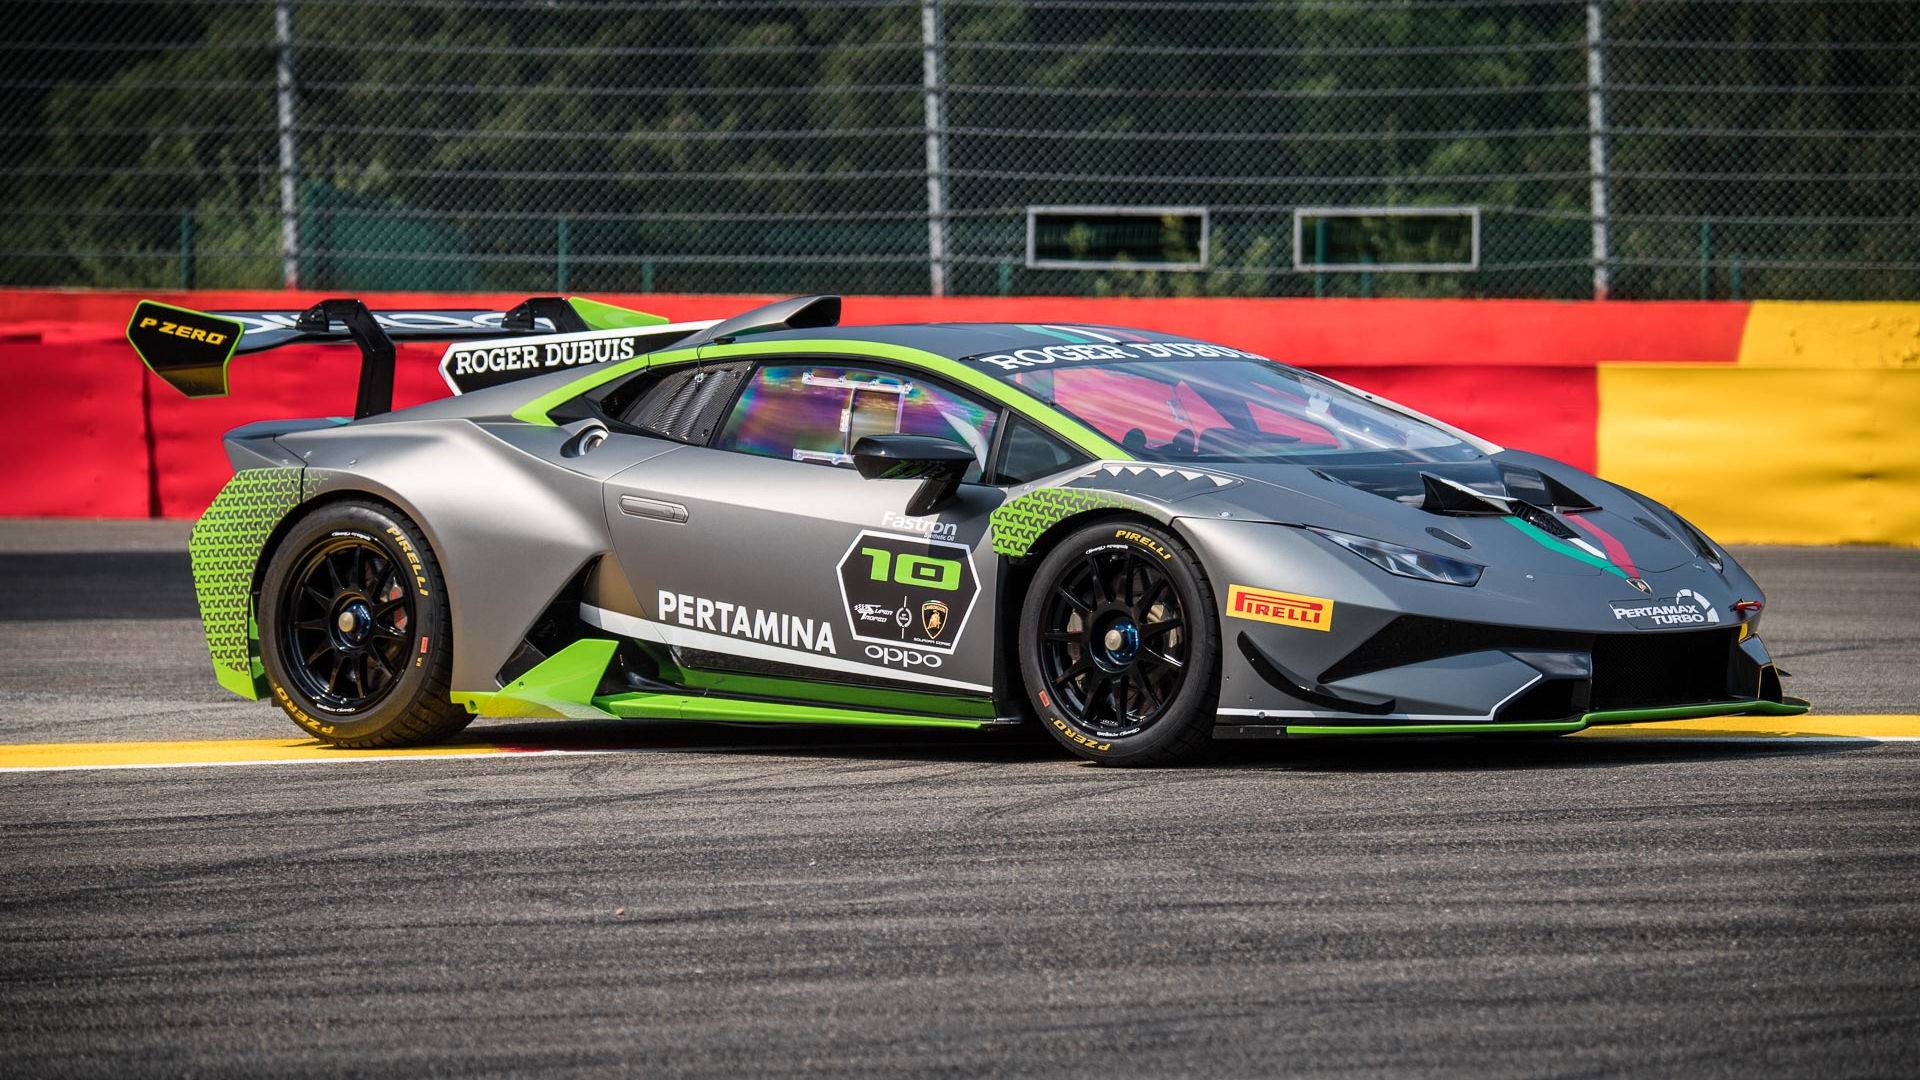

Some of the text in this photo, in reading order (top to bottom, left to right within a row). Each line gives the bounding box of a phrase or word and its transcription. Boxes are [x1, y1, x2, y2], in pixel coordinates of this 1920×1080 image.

[140, 317, 225, 345] P ZERO
[455, 337, 635, 375] ROGER DUBUIS
[979, 343, 1138, 371] ROGER
[881, 511, 958, 536] Fastron
[1115, 529, 1172, 560] PIRELLI
[386, 527, 429, 597] PIRELLI
[861, 547, 962, 591] 10
[658, 590, 837, 655] PERTAMINA
[1235, 592, 1322, 623] PIRELLI
[1609, 603, 1700, 620] PERTAMAX
[1651, 614, 1705, 625] TURBO
[864, 645, 942, 668] oppo
[275, 687, 322, 730] ZERO
[1053, 719, 1099, 749] ZERO
